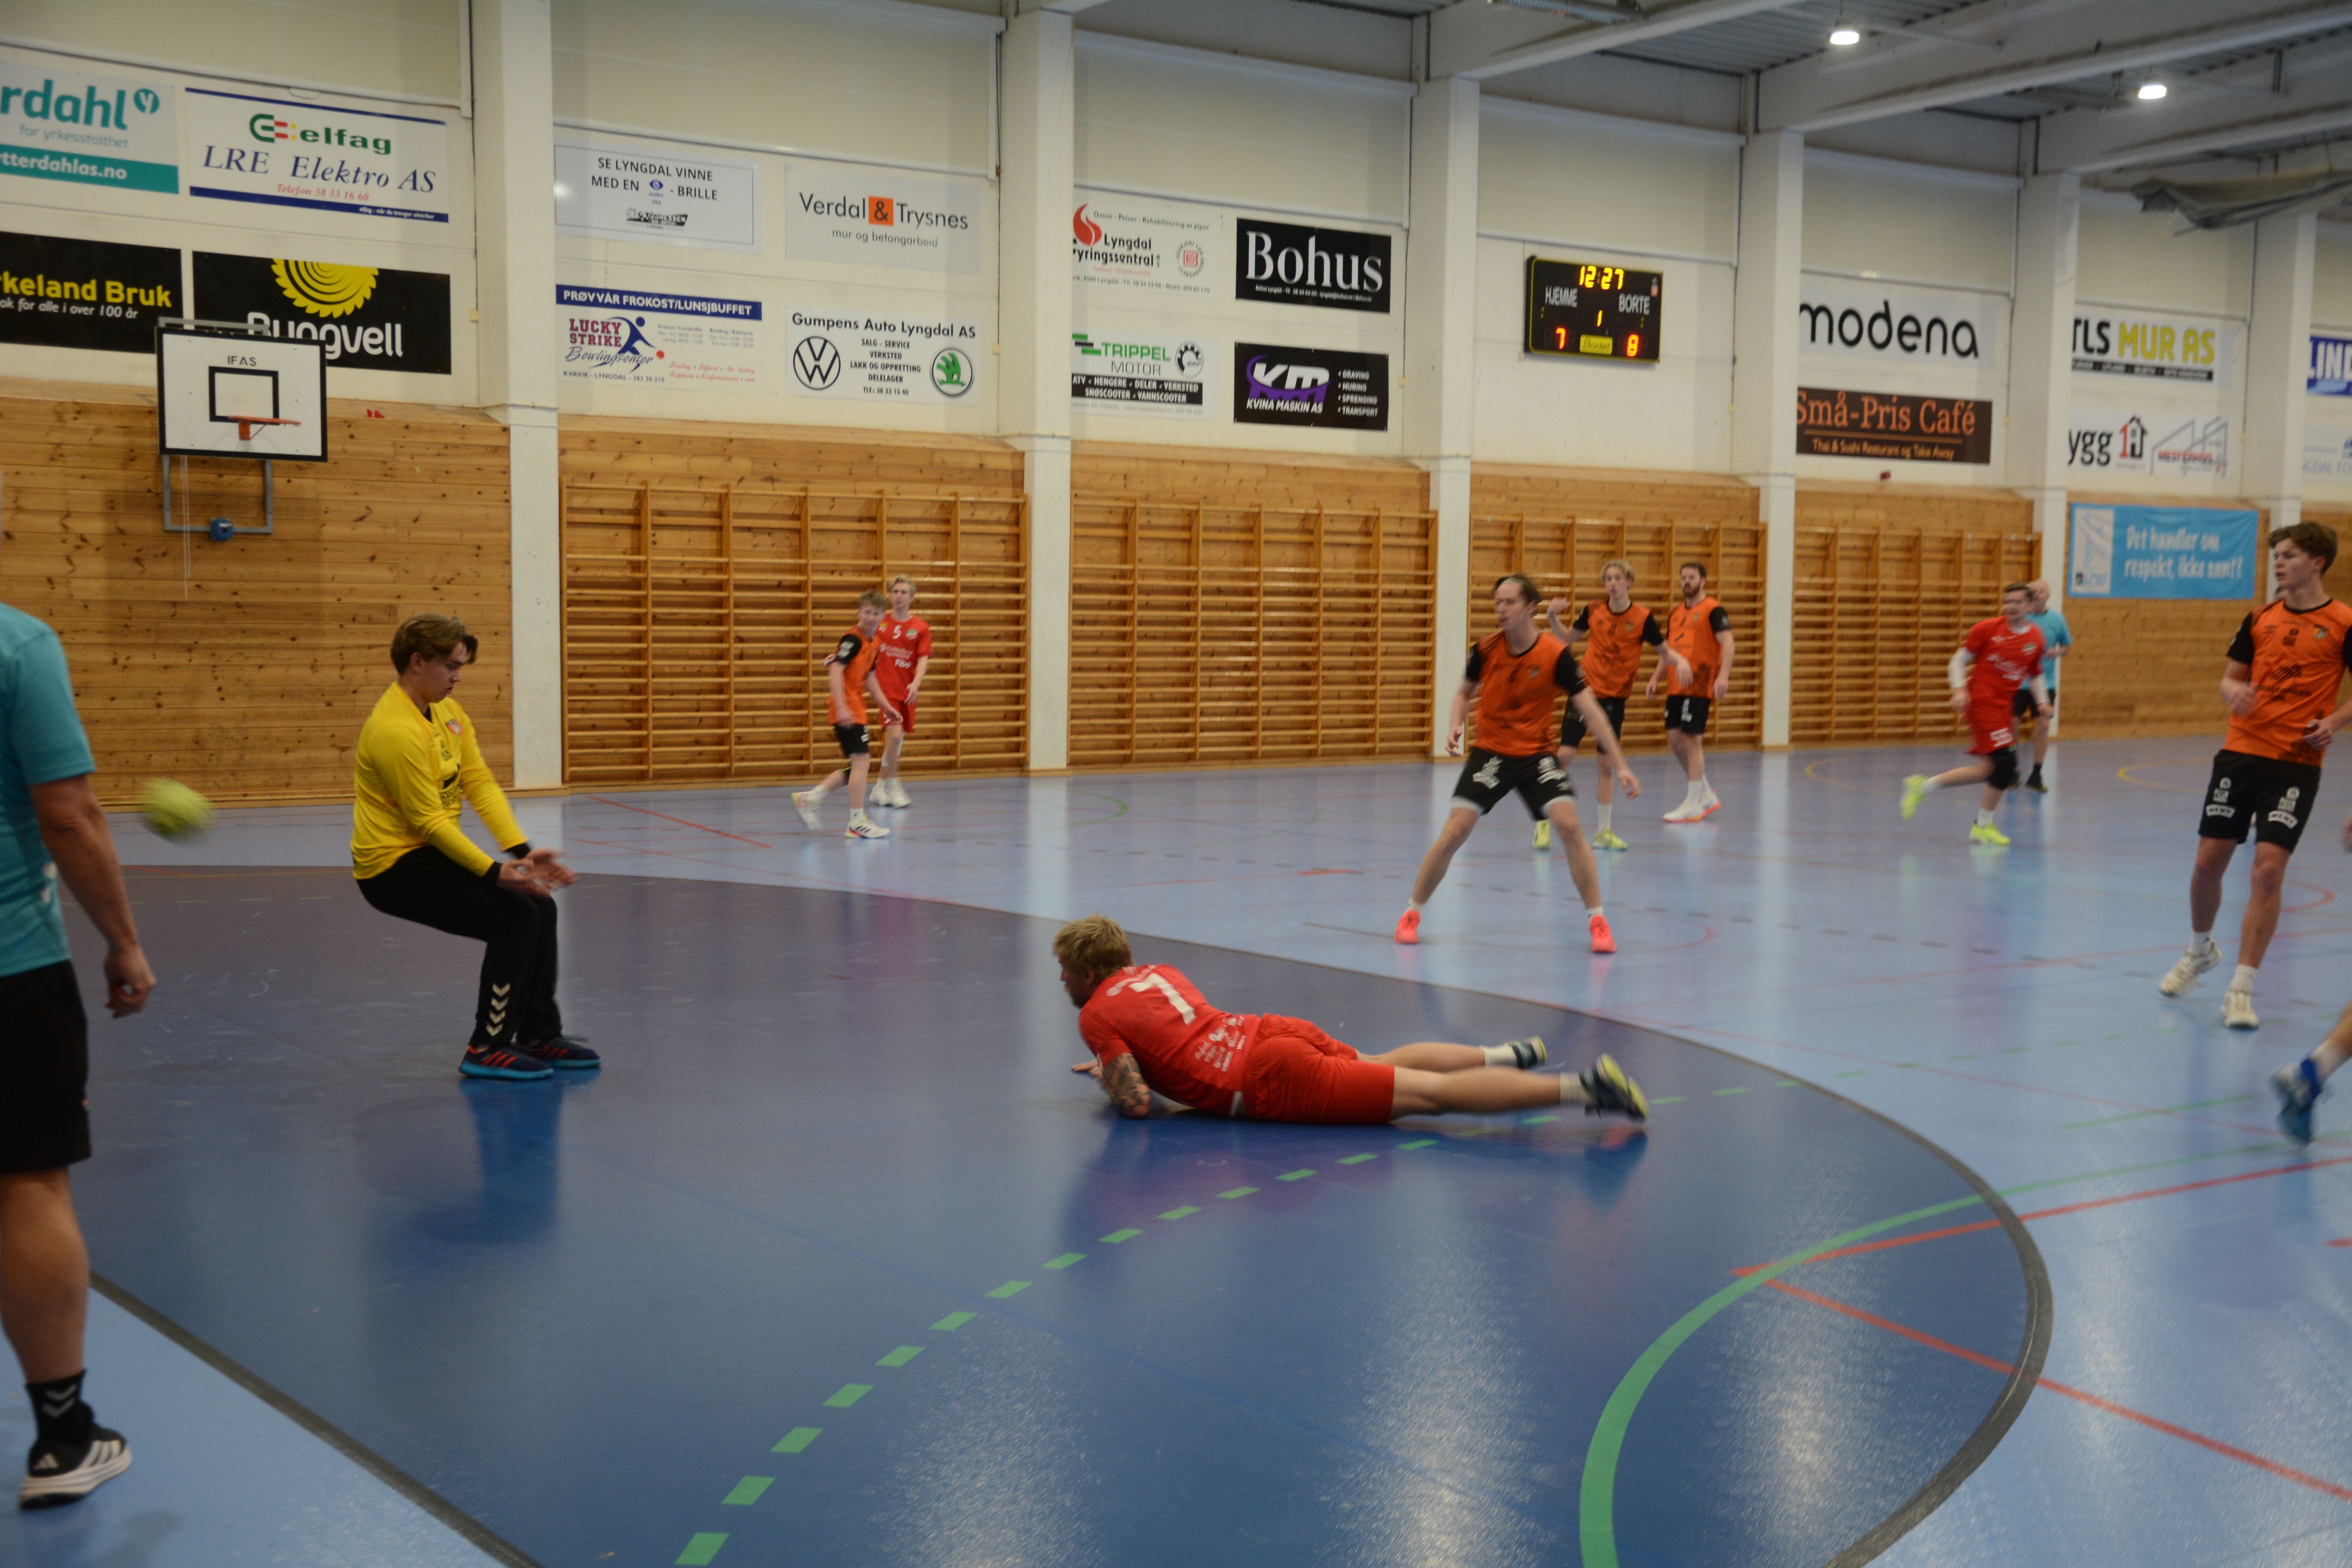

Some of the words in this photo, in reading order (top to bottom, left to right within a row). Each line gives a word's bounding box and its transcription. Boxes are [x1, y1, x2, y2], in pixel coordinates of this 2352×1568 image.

[20, 124, 39, 137] for
[44, 127, 129, 148] yrkesstolthet
[300, 127, 391, 155] elfag
[203, 145, 269, 174] LRE
[290, 156, 389, 188] Elektro
[397, 169, 437, 193] AS
[598, 158, 611, 169] SE
[615, 160, 672, 176] LYNGDAL
[675, 167, 713, 181] VINNE
[277, 183, 312, 196] Telefon
[315, 187, 327, 196] 38
[329, 189, 341, 199] 33
[344, 191, 355, 200] 16
[358, 193, 369, 201] 60
[591, 175, 619, 189] MED
[623, 180, 639, 191] EN
[678, 186, 717, 200] BRILLE
[799, 192, 866, 219] Verdal
[873, 200, 889, 222] &
[896, 202, 969, 230] Trysnes
[1142, 216, 1185, 229] Rehabilitering
[832, 230, 853, 239] mur
[856, 233, 868, 243] og
[872, 231, 938, 247] betongarbeid
[1104, 233, 1152, 251] Lyngdal
[1246, 230, 1383, 293] Bohus
[1579, 265, 1624, 290] 12:27
[0, 271, 97, 301] keland
[105, 280, 172, 307] Bruk
[18, 298, 35, 312] for
[38, 301, 59, 312] alle
[63, 303, 66, 313] i
[70, 306, 94, 315] over
[100, 305, 122, 318] 100
[126, 307, 138, 318] år
[563, 290, 597, 301] PRØV
[596, 292, 621, 305] VÅR
[622, 295, 752, 315] FROKOST/LUNSJBUFFET
[1545, 285, 1578, 307] HJEMME
[1619, 293, 1650, 315] BORTE
[570, 319, 622, 335] LUCKY
[792, 312, 859, 331] Gumpens
[864, 318, 896, 332] Auto
[901, 321, 954, 339] Lyngdal
[959, 326, 976, 338] AS
[1799, 299, 1979, 358] modena
[570, 333, 622, 347] STRIKE
[861, 338, 878, 347] SALG
[884, 340, 910, 349] SERVICE
[1555, 327, 1566, 350] 7
[1626, 334, 1639, 357] 8
[2118, 322, 2175, 362] MUR
[2183, 328, 2215, 365] AS
[227, 356, 257, 366] IFAS
[565, 346, 654, 367] Bowlingsenter
[870, 351, 902, 360] VERKSTED
[1101, 343, 1171, 361] TRIPPEL
[850, 361, 867, 369] LAKK
[881, 363, 921, 373] OPPRETTING
[1111, 361, 1161, 376] MOTOR
[1342, 369, 1370, 380] GRAVING
[868, 374, 903, 383] DELELAGER
[1072, 375, 1086, 385] ATV
[1094, 376, 1127, 388] HENGERE
[1135, 378, 1157, 390] DELER
[1163, 381, 1199, 393] VERKSTED
[1342, 382, 1367, 392] MURING
[1085, 387, 1131, 400] SNØSCOOTER
[1137, 391, 1187, 404] VANNSCOOTER
[1342, 394, 1377, 405] SPRENGING
[1246, 397, 1274, 410] KVINA
[1276, 399, 1310, 413] MASKIN
[1310, 402, 1323, 414] AS
[1342, 406, 1378, 417] TRANSPORT
[1920, 399, 1976, 435] Café
[2126, 524, 2147, 551] Det
[893, 624, 902, 639] 5
[1129, 973, 1196, 1025] 7
